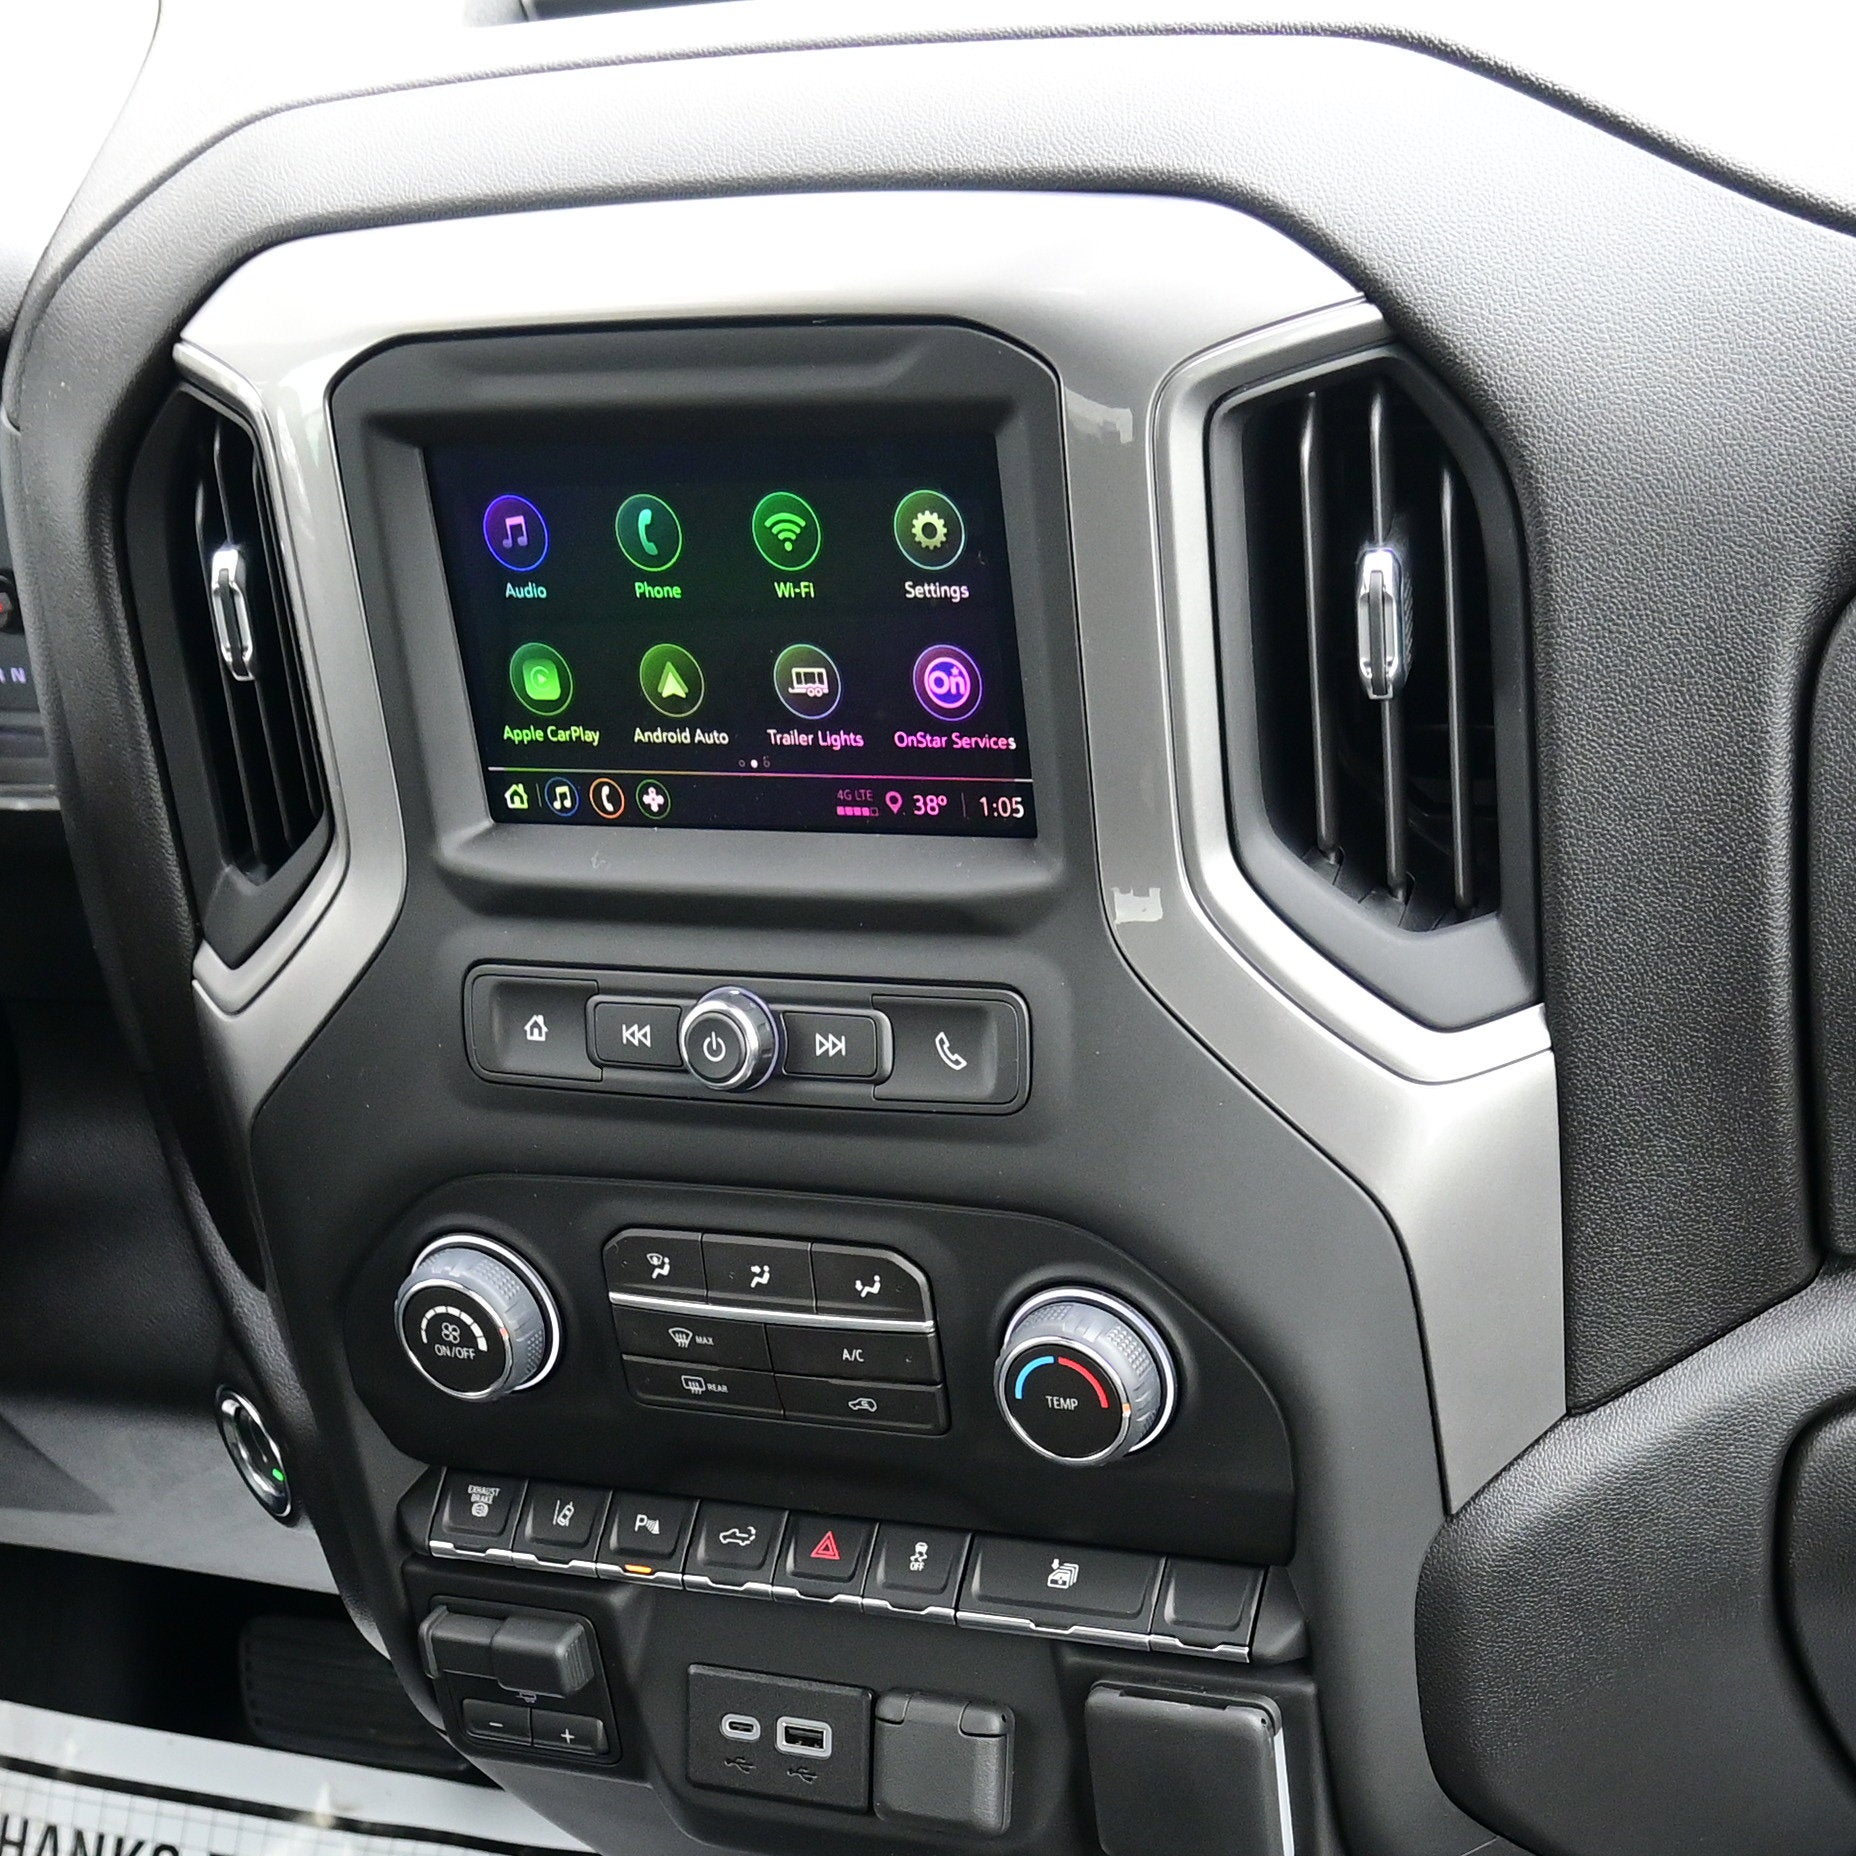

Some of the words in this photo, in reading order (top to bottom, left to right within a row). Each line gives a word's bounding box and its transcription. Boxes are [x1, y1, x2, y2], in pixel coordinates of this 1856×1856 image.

[505, 583, 547, 599] Audio
[634, 582, 682, 599] Phone
[774, 582, 814, 598] Wi-Fi
[904, 582, 969, 602] Settings
[11, 667, 26, 684] N
[503, 726, 544, 745] Apple
[548, 726, 600, 746] CarPlay
[633, 728, 690, 745] Android
[694, 729, 729, 745] Auto
[766, 730, 815, 746] Trailer
[818, 730, 864, 750] Lights
[894, 732, 947, 749] OnStar
[952, 733, 1016, 750] Services
[837, 789, 851, 800] 4G
[855, 789, 873, 800] LTE
[979, 797, 1025, 818] 1:05
[695, 1335, 714, 1345] MAX
[435, 1344, 475, 1359] ON/OFF
[842, 1349, 864, 1362] A/C
[707, 1383, 728, 1393] REAR
[1045, 1396, 1078, 1410] TEMP
[468, 1485, 501, 1497] EXHAUST
[910, 1562, 924, 1571] OFF
